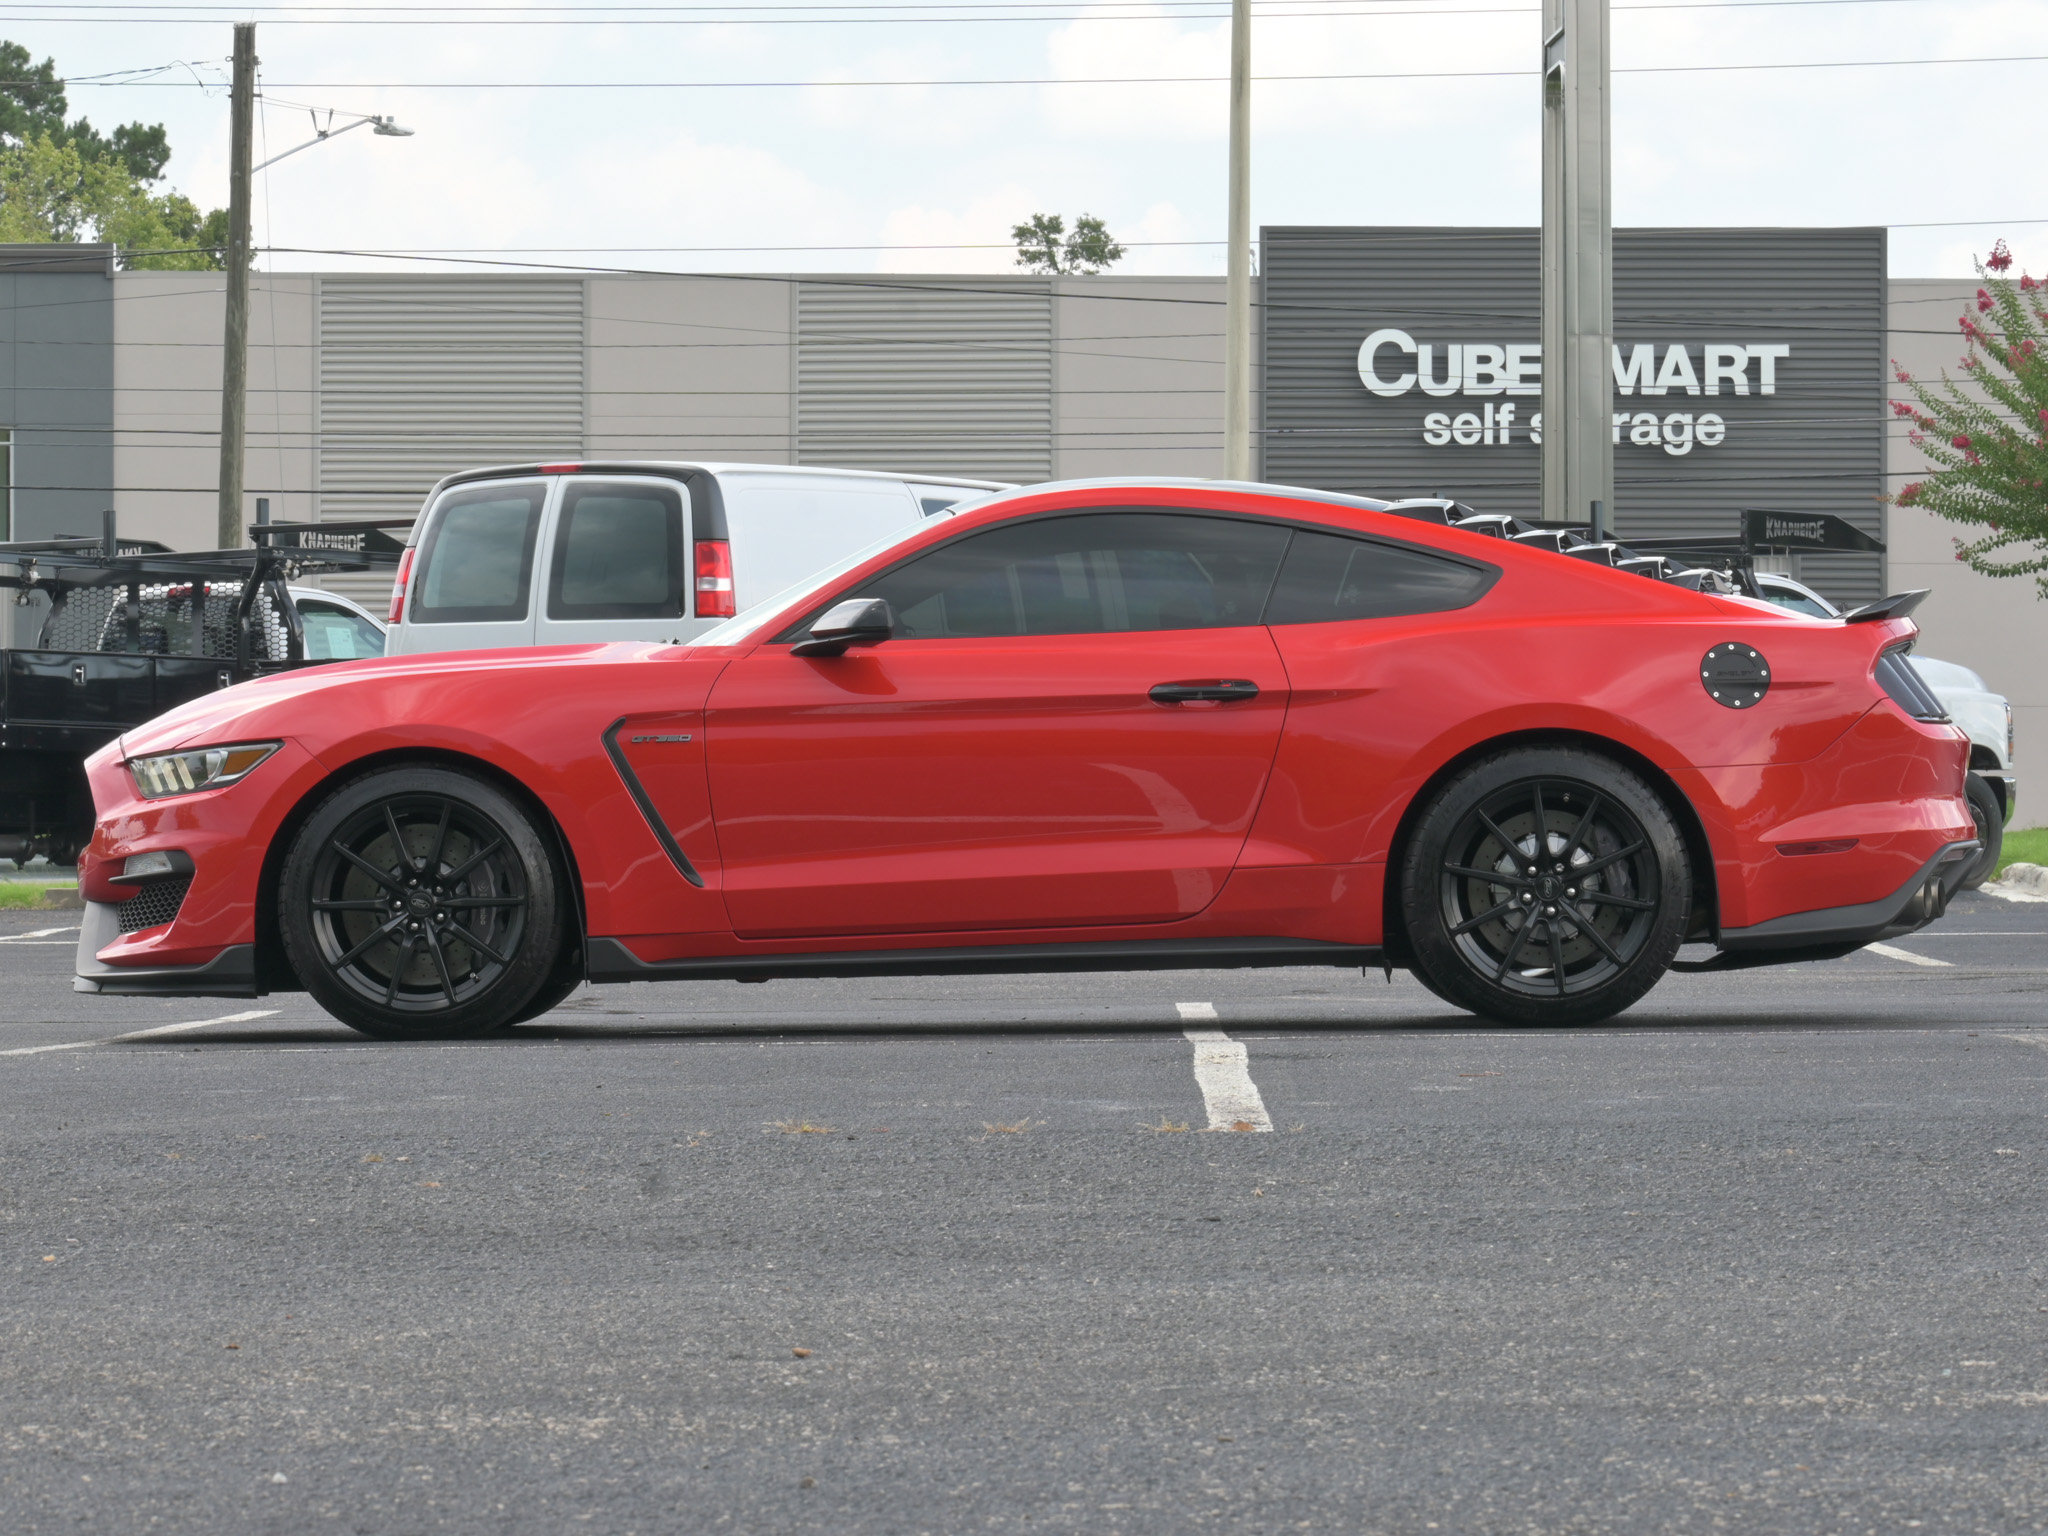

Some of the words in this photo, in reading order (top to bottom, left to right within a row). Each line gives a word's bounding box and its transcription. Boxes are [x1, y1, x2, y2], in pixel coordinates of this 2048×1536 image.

[1357, 328, 1790, 397] CUBEMART
[1423, 403, 1515, 446] self
[1530, 411, 1726, 456] srage
[1766, 516, 1825, 543] KNAPHEIDE
